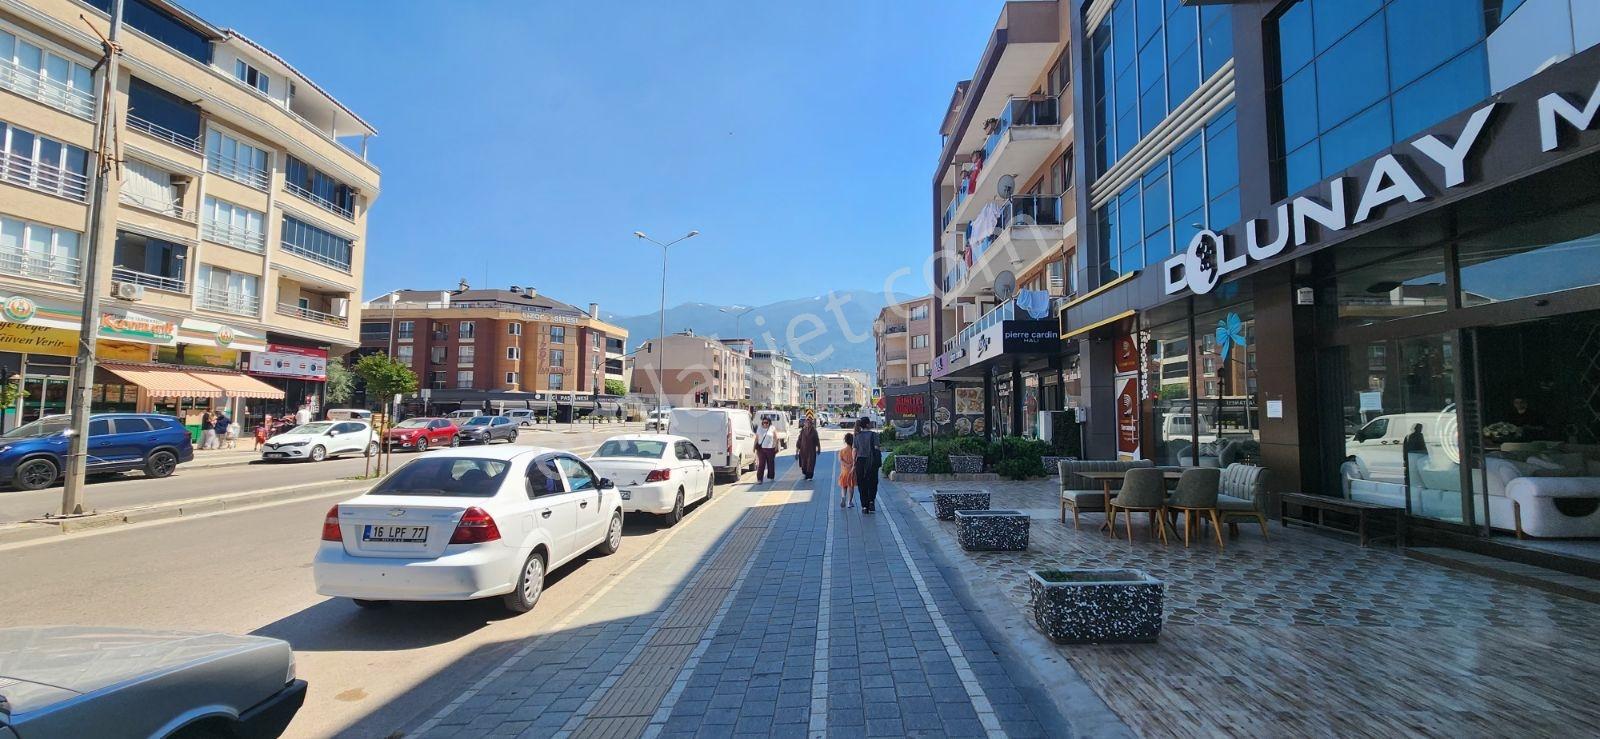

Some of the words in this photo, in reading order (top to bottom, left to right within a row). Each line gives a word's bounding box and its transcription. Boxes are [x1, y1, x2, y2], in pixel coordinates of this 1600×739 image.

[1005, 331, 1029, 339] pierre
[1031, 331, 1058, 339] cardin
[374, 527, 384, 538] 16
[389, 527, 407, 538] LPF
[412, 528, 425, 539] 77
